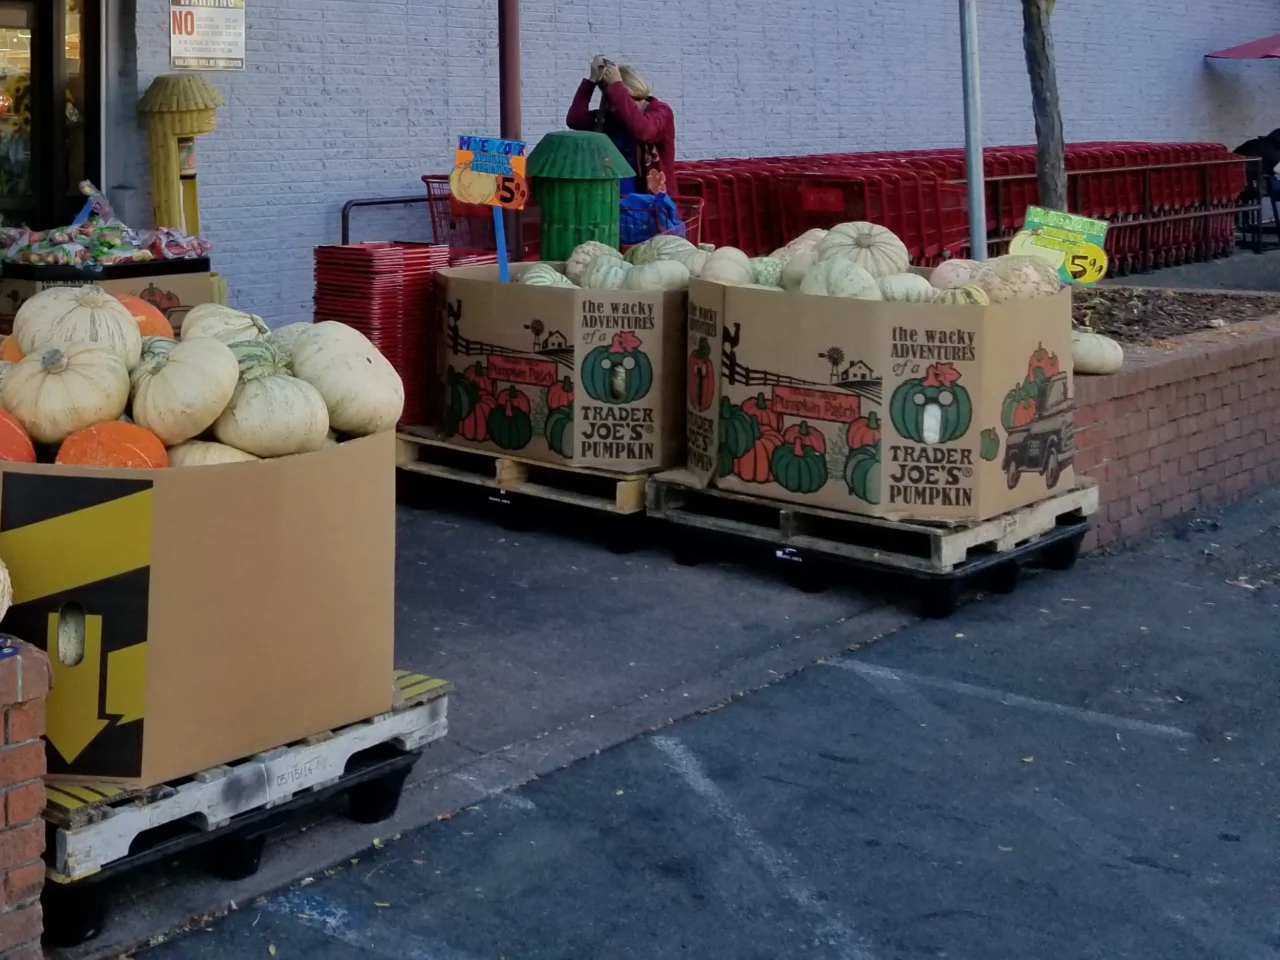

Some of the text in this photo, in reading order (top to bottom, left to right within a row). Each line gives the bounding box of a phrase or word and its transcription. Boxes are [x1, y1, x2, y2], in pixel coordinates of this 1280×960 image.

[172, 10, 195, 36] NO
[582, 300, 654, 317] the wacky
[581, 315, 655, 330] ADVENTURES
[582, 329, 607, 344] of a
[892, 326, 976, 346] the wacky
[891, 344, 976, 361] ADVENTURES
[892, 360, 920, 377] of a
[581, 406, 654, 423] TRADER
[774, 394, 856, 419] Pumpkin Patch
[581, 442, 654, 460] PUMPKIN
[889, 446, 974, 465] TRADER
[889, 485, 973, 507] PUMPKIN
